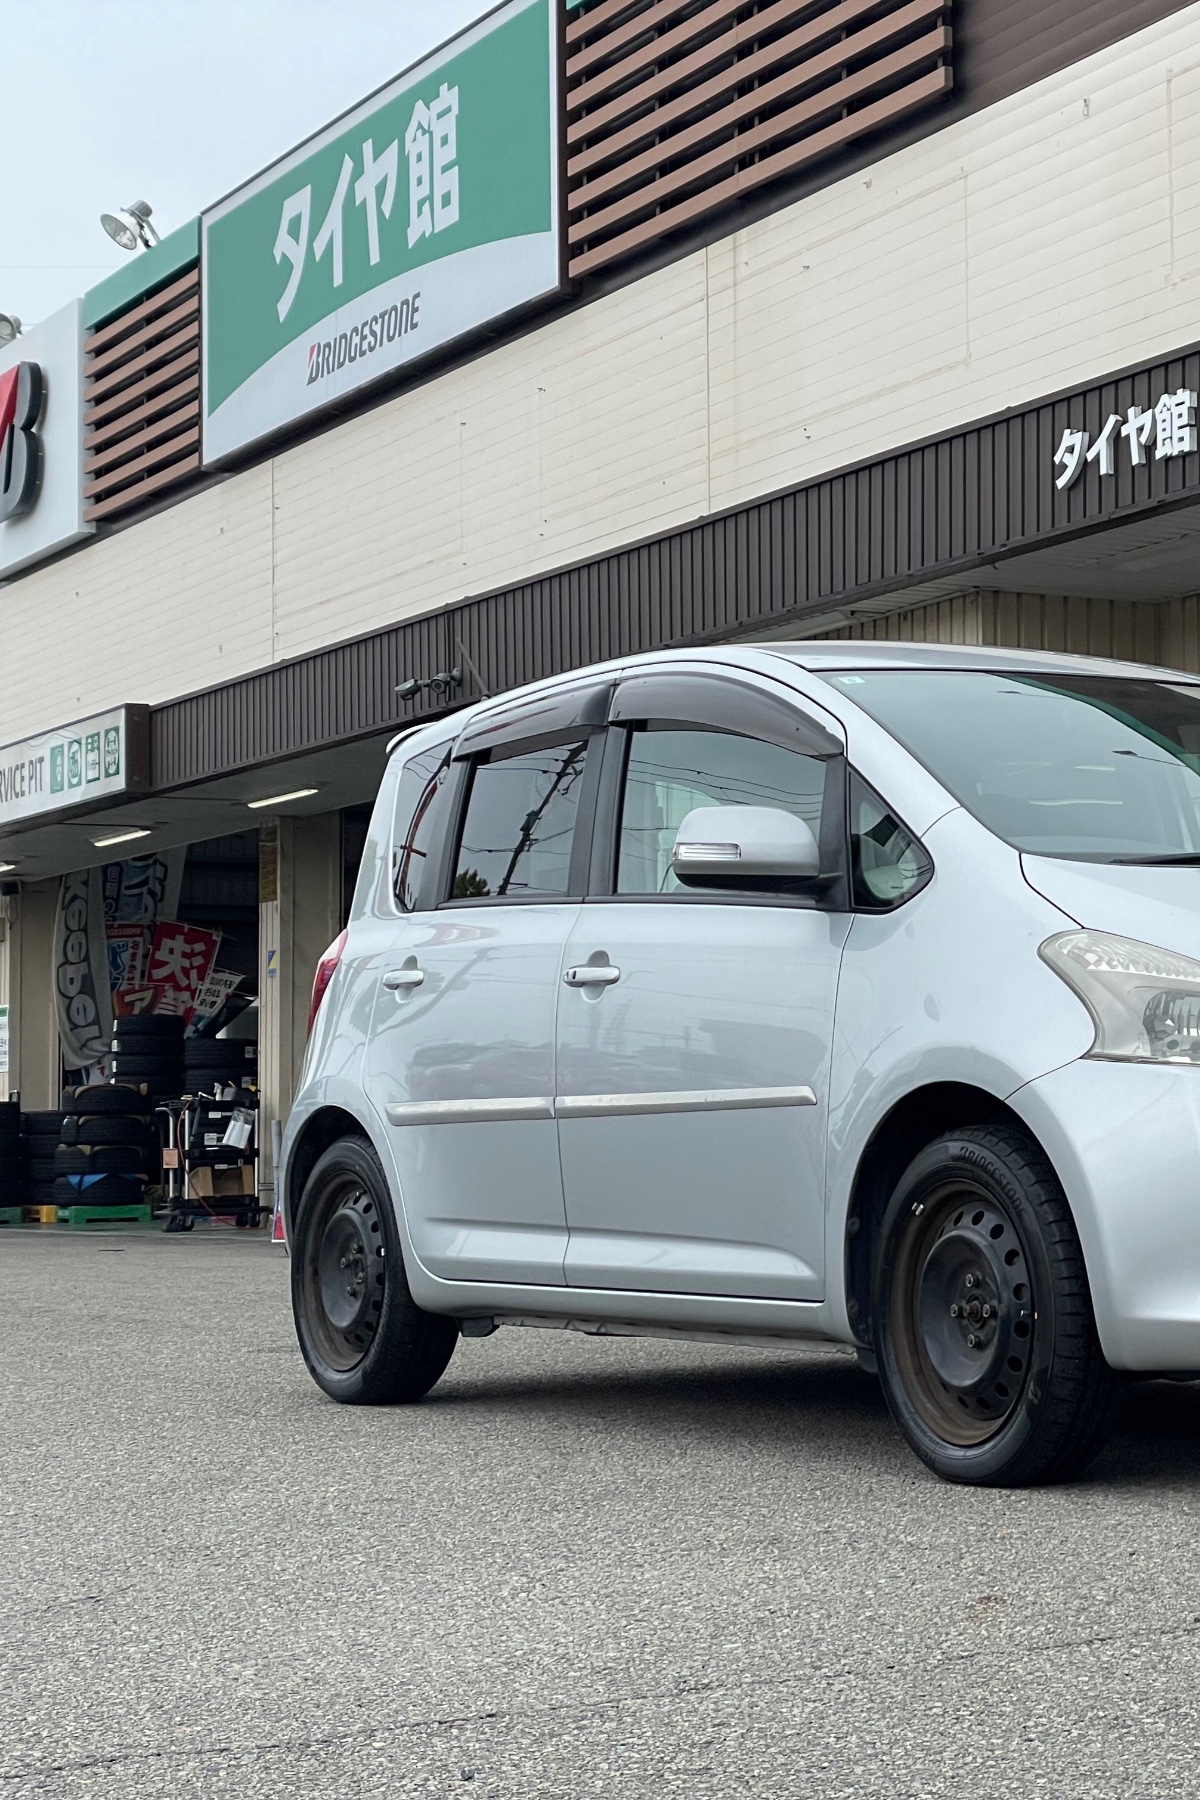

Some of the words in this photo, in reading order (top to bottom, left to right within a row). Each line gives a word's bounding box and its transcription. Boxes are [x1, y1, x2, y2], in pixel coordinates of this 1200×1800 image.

[272, 81, 459, 324] タイヤ館
[306, 291, 421, 386] BRIDGESTONE
[1053, 388, 1197, 490] タイヤ館
[28, 755, 45, 795] PIT
